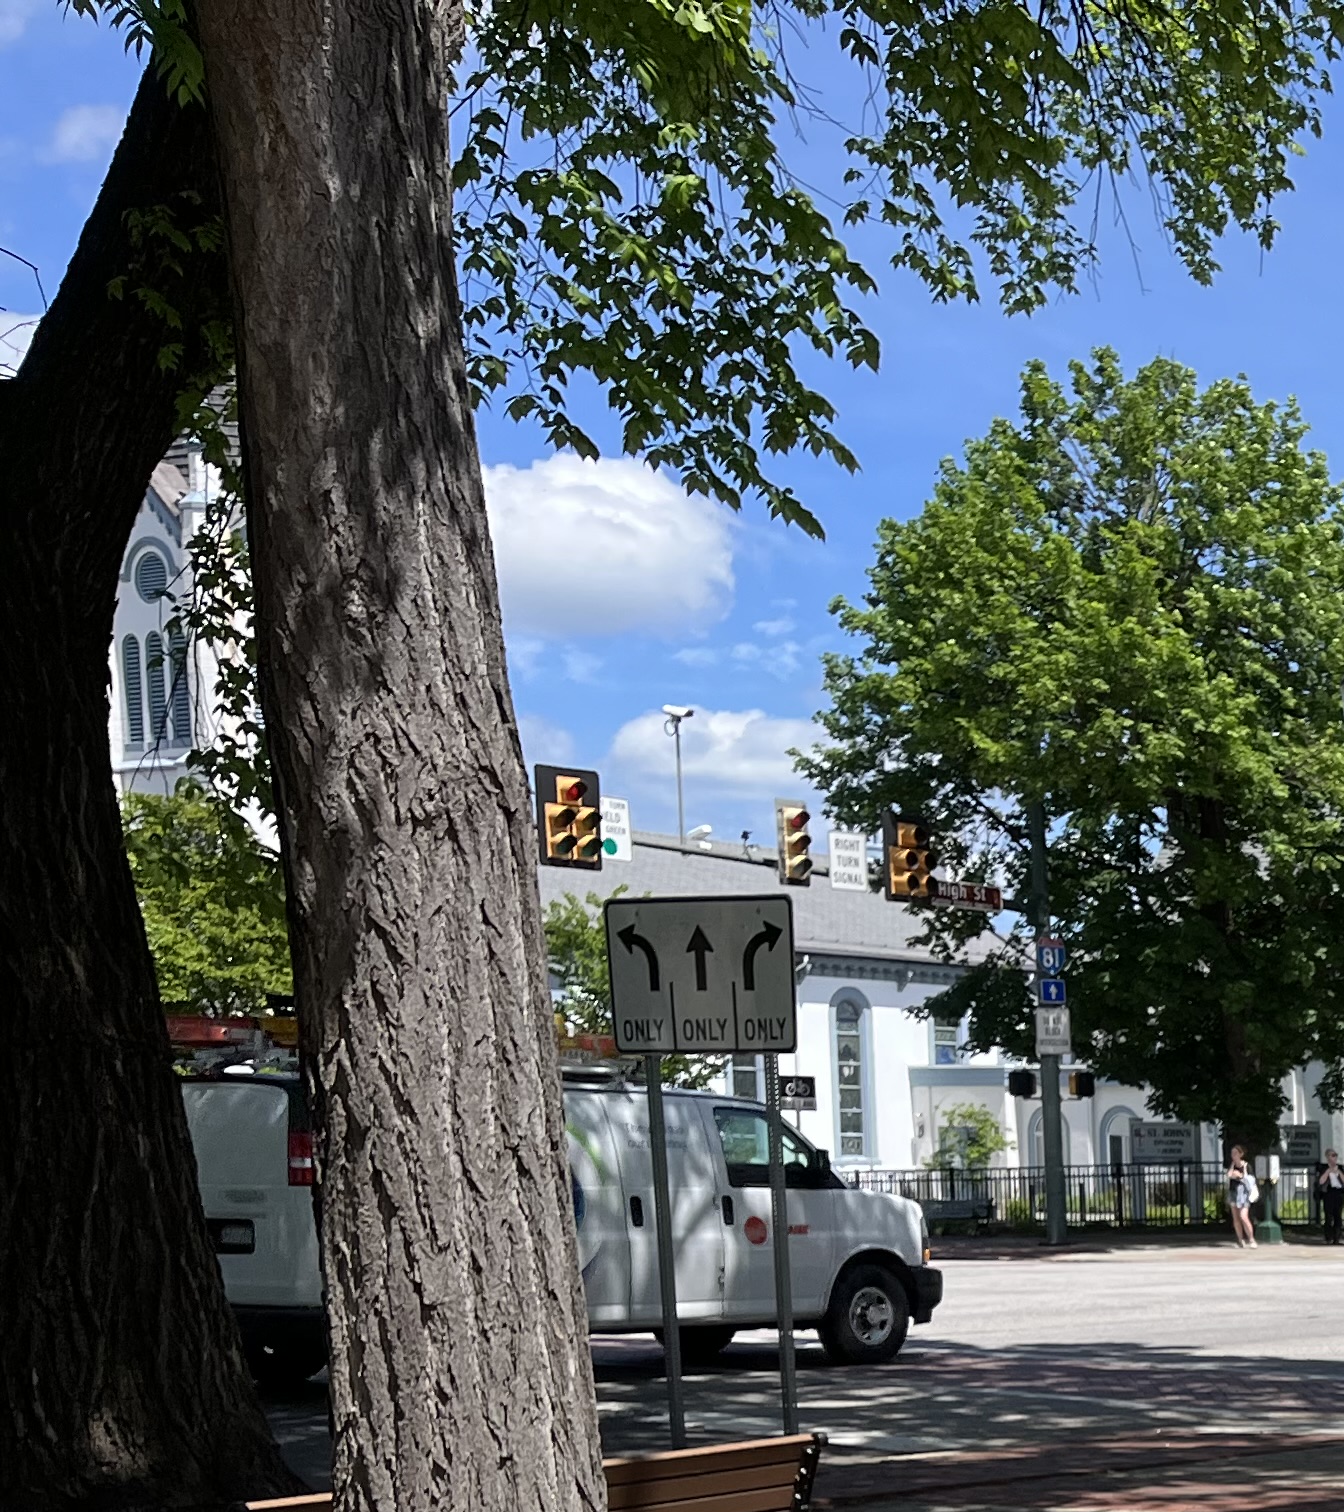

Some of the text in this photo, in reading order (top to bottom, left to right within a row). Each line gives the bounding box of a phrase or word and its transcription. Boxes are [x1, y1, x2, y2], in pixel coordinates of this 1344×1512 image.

[834, 838, 860, 851] RIGHT
[837, 856, 860, 868] TURN
[833, 871, 865, 885] SIGNAL
[938, 883, 987, 902] High St
[1042, 948, 1060, 968] 81
[623, 1017, 786, 1042] ONLY ONLY ONLY
